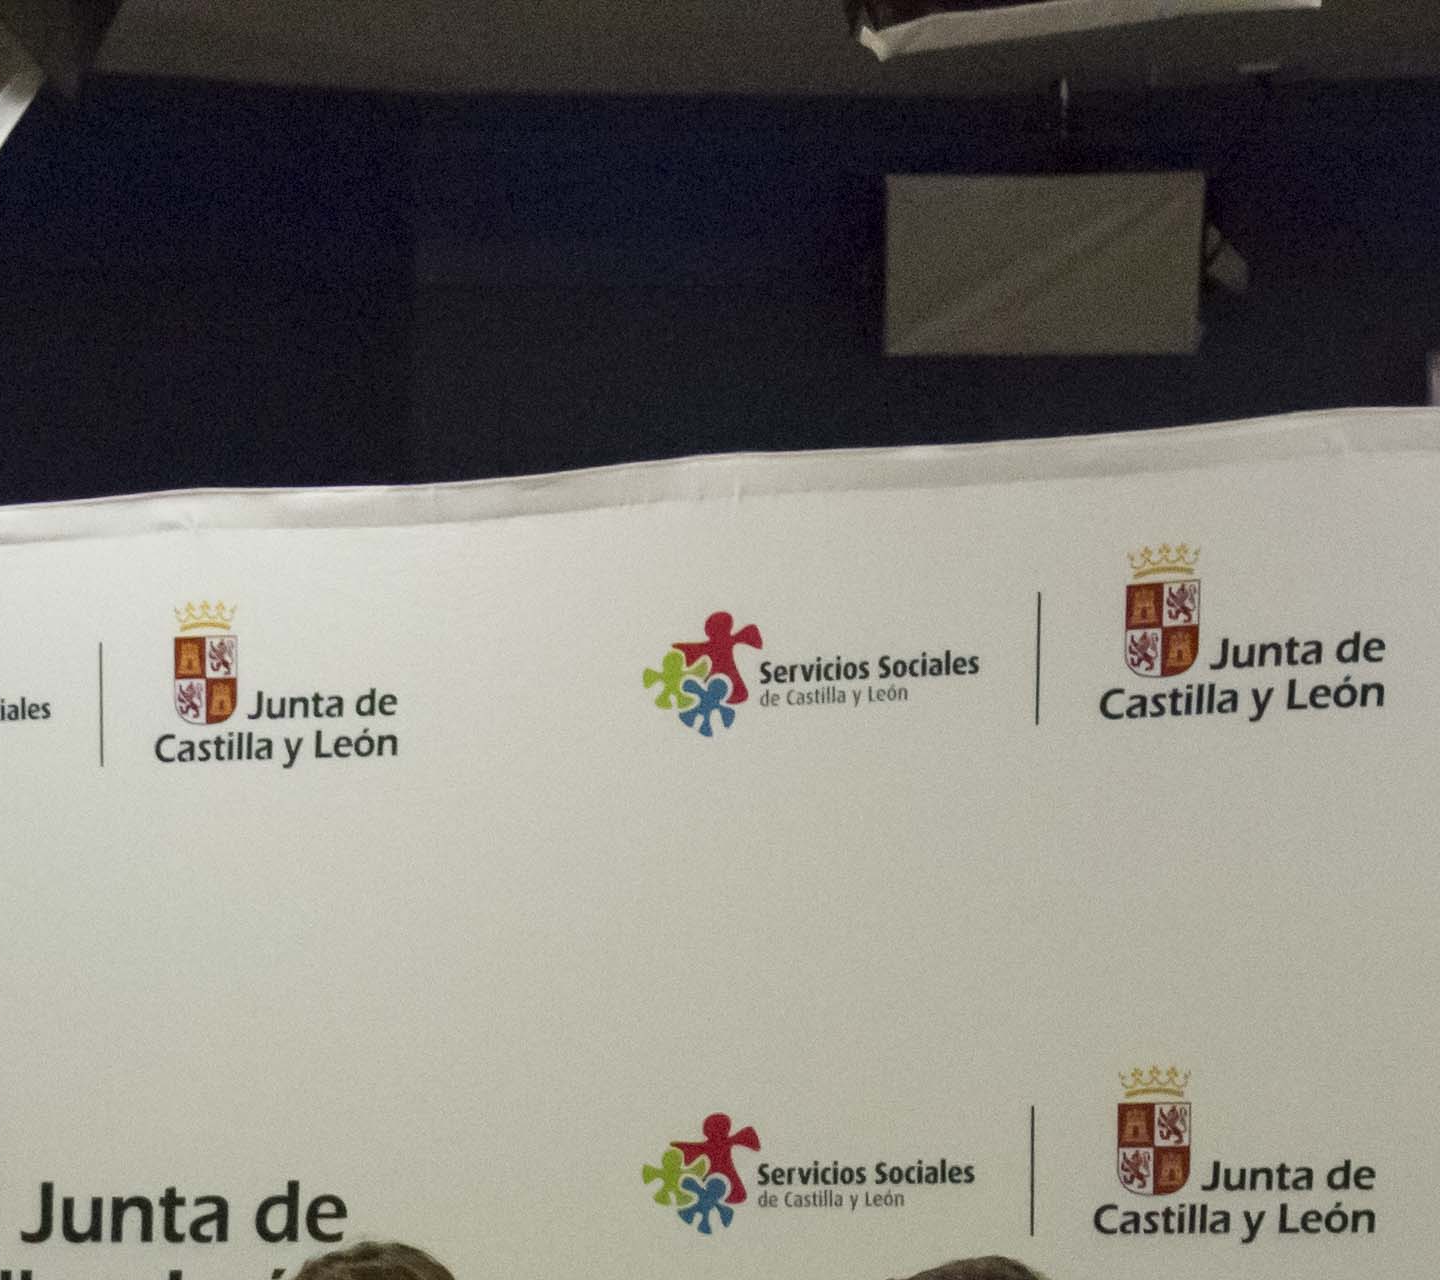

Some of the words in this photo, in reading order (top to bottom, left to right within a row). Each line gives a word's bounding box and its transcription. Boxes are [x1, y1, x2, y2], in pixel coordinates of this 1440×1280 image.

[759, 655, 871, 685] Servicios
[878, 649, 980, 680] Sociales
[1209, 636, 1323, 671] Junta
[1335, 631, 1386, 664] de
[247, 690, 345, 721] Junta
[355, 687, 398, 718] de
[758, 688, 781, 708] de
[785, 685, 847, 706] Castilla
[851, 689, 862, 707] y
[867, 684, 909, 703] León
[1099, 682, 1239, 721] Castilla
[1248, 687, 1274, 723] y
[1286, 675, 1385, 711] León
[154, 731, 274, 764] Castilla
[282, 737, 304, 770] y
[314, 728, 398, 759] León
[757, 1160, 867, 1187] Servicios
[874, 1158, 976, 1186] Sociales
[1200, 1160, 1314, 1192] Junta
[1326, 1159, 1376, 1191] de
[20, 1181, 229, 1245] Junta
[254, 1179, 348, 1244] de
[757, 1190, 779, 1209] de
[783, 1188, 844, 1209] Castilla
[849, 1194, 859, 1211] y
[864, 1189, 905, 1208] León
[1093, 1203, 1231, 1236] Castilla
[1241, 1210, 1266, 1245] y
[1278, 1201, 1376, 1235] León
